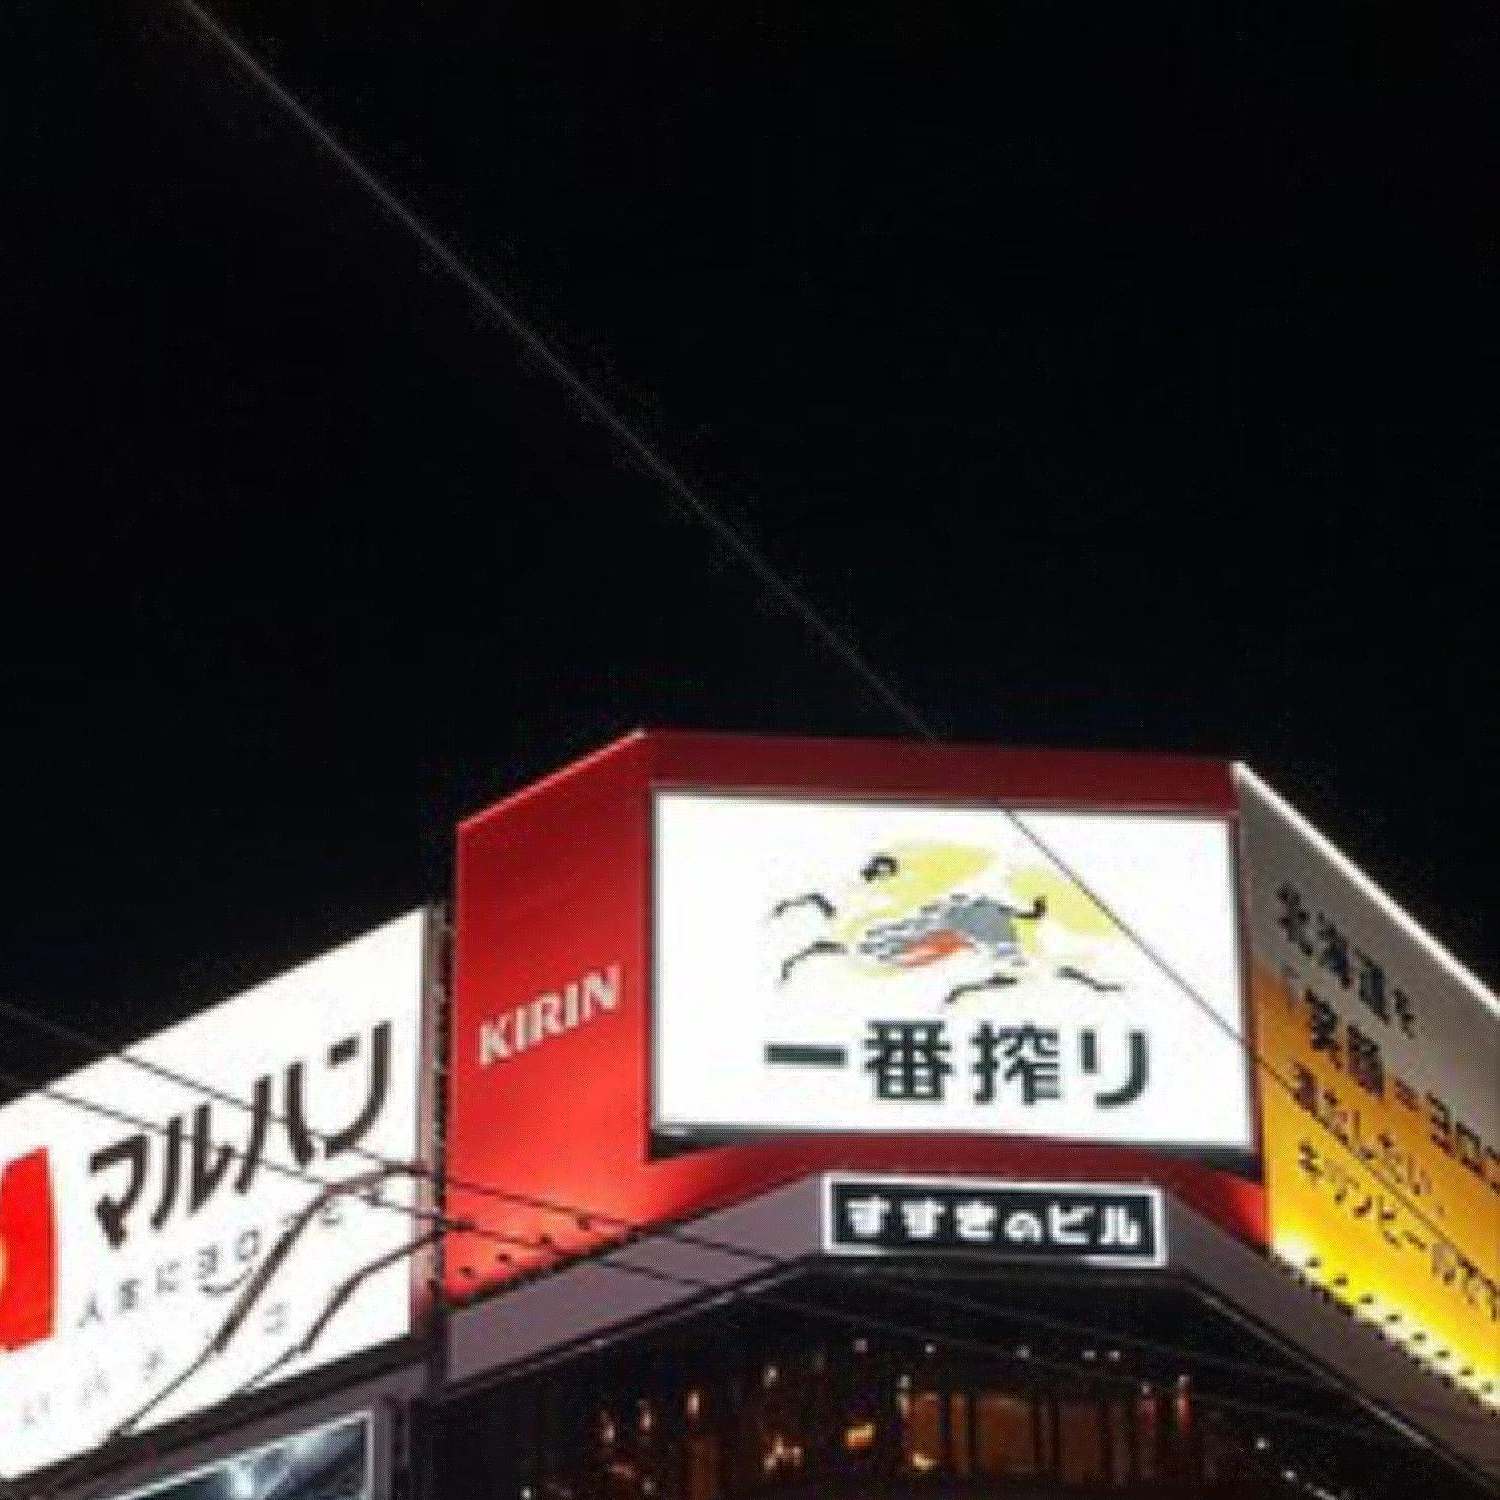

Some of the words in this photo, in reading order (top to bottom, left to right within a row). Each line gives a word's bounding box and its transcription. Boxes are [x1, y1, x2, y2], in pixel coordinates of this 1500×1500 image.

[476, 963, 623, 1069] KIRIN
[763, 1019, 1148, 1107] 一番搾り
[86, 1019, 394, 1250] マルハン
[843, 1193, 1140, 1250] すすきのビル
